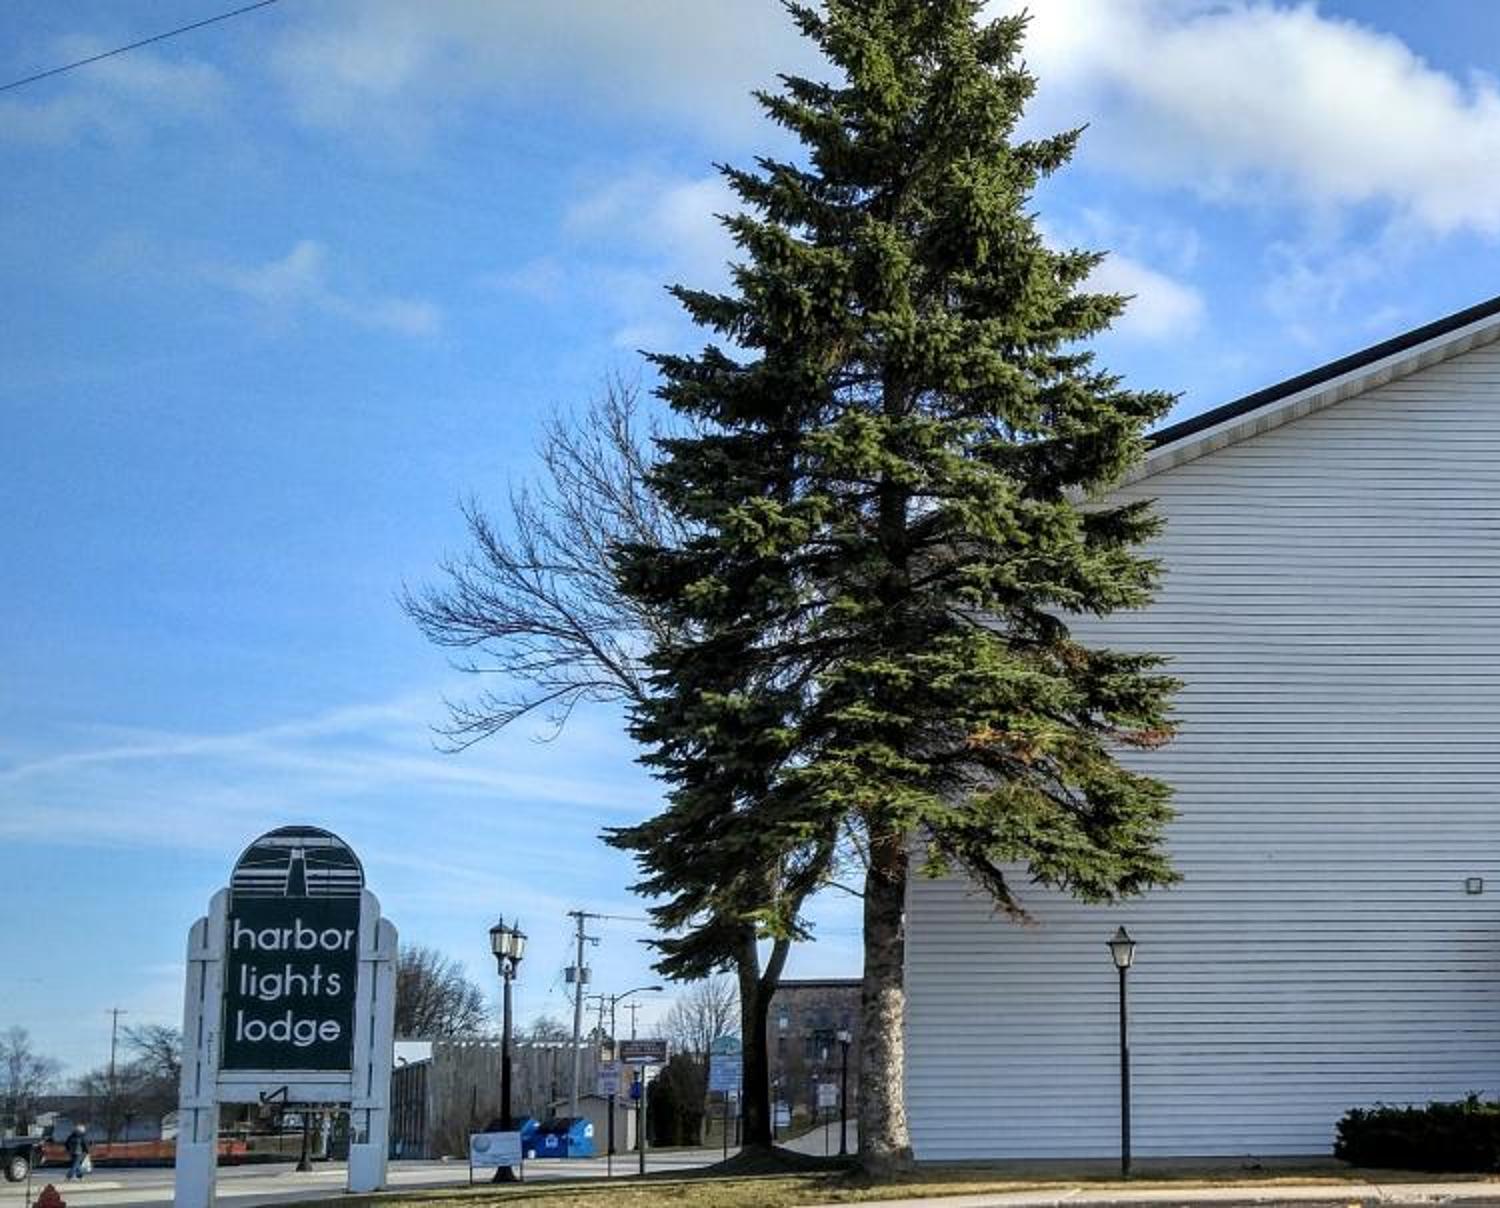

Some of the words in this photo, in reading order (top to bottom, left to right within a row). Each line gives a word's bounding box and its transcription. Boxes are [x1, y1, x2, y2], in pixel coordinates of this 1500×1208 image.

[233, 918, 355, 950] harbor
[240, 964, 341, 1001] lights
[236, 1010, 341, 1047] lodge
